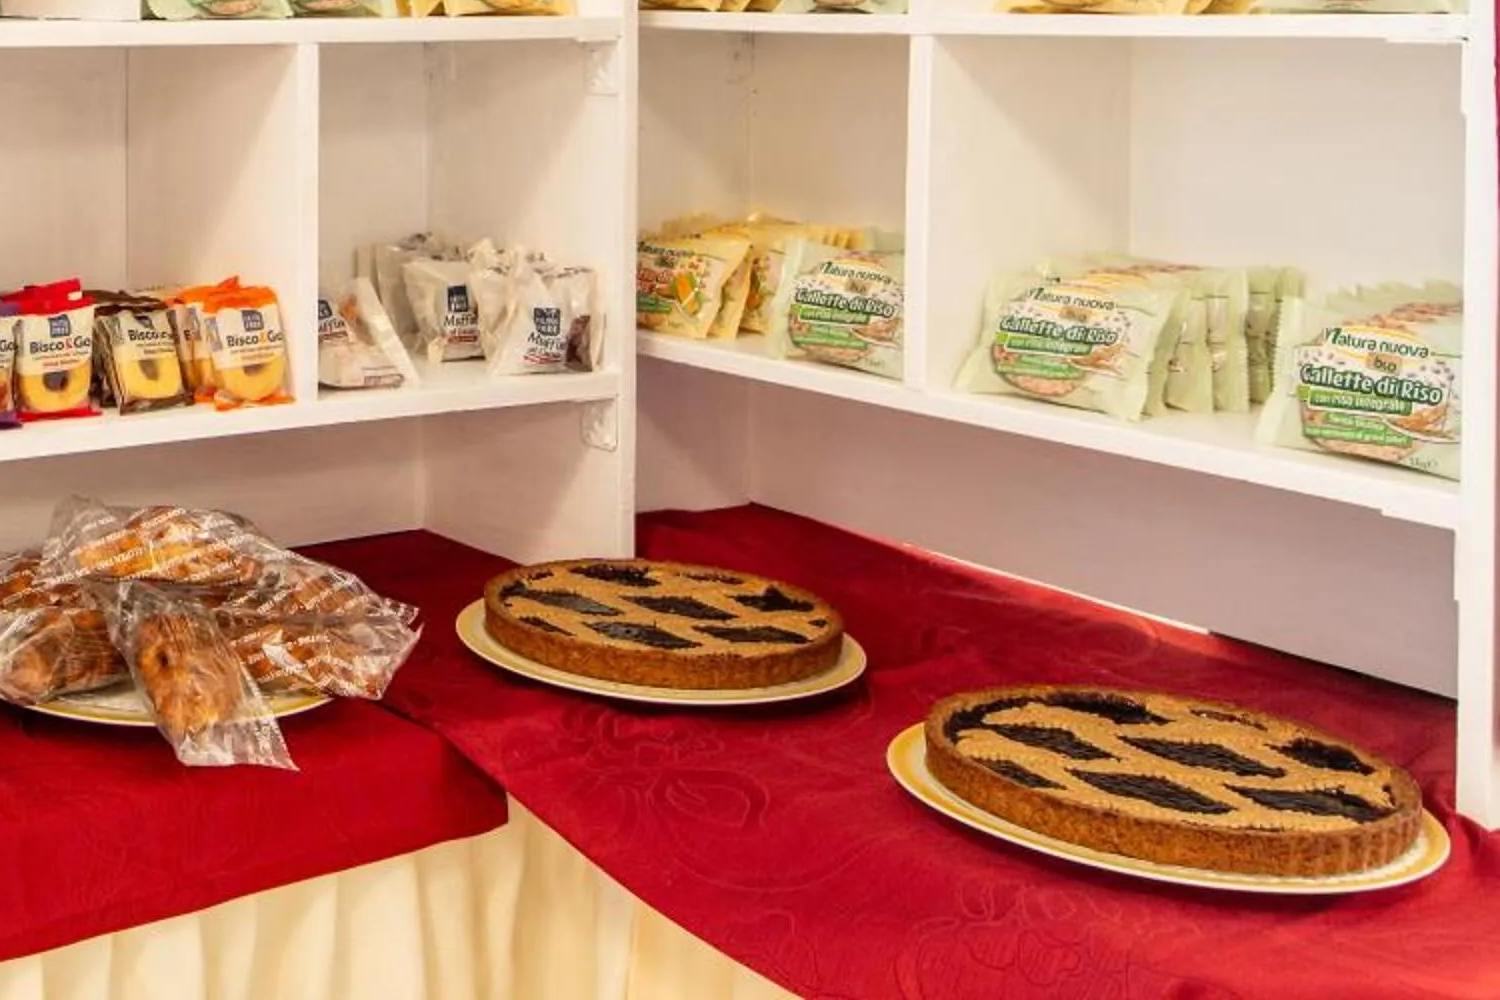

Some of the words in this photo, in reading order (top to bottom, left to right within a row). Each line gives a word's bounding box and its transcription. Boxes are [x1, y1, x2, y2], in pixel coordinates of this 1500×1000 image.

[1379, 341, 1430, 359] nuova
[1376, 377, 1398, 397] di
[1400, 379, 1443, 405] Riso
